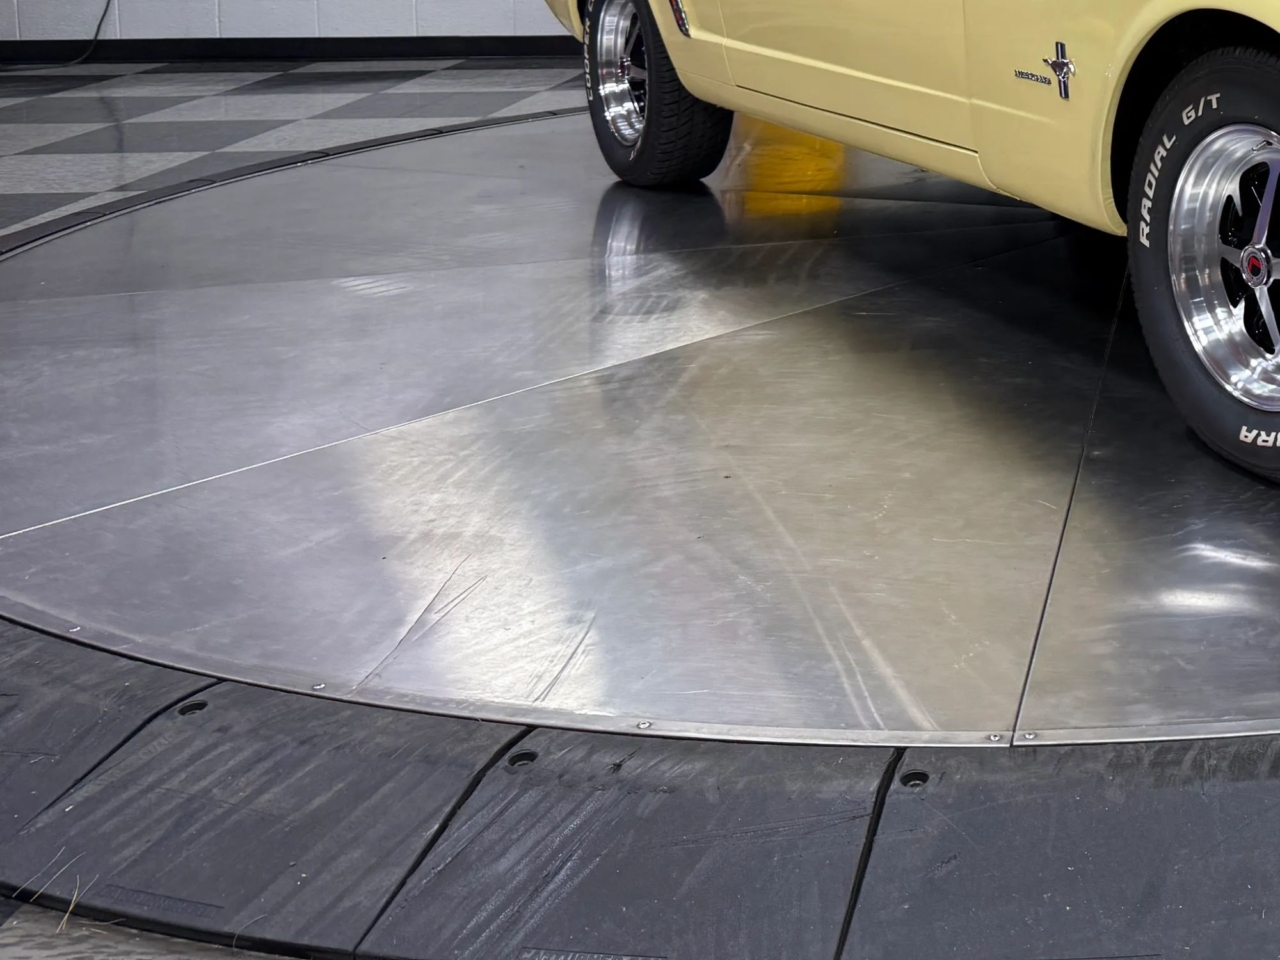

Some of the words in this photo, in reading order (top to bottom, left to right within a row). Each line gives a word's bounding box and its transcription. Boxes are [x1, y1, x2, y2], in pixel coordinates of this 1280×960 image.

[584, 18, 593, 101] COOPER
[1139, 133, 1177, 249] RADIAL
[1182, 93, 1220, 126] G/T
